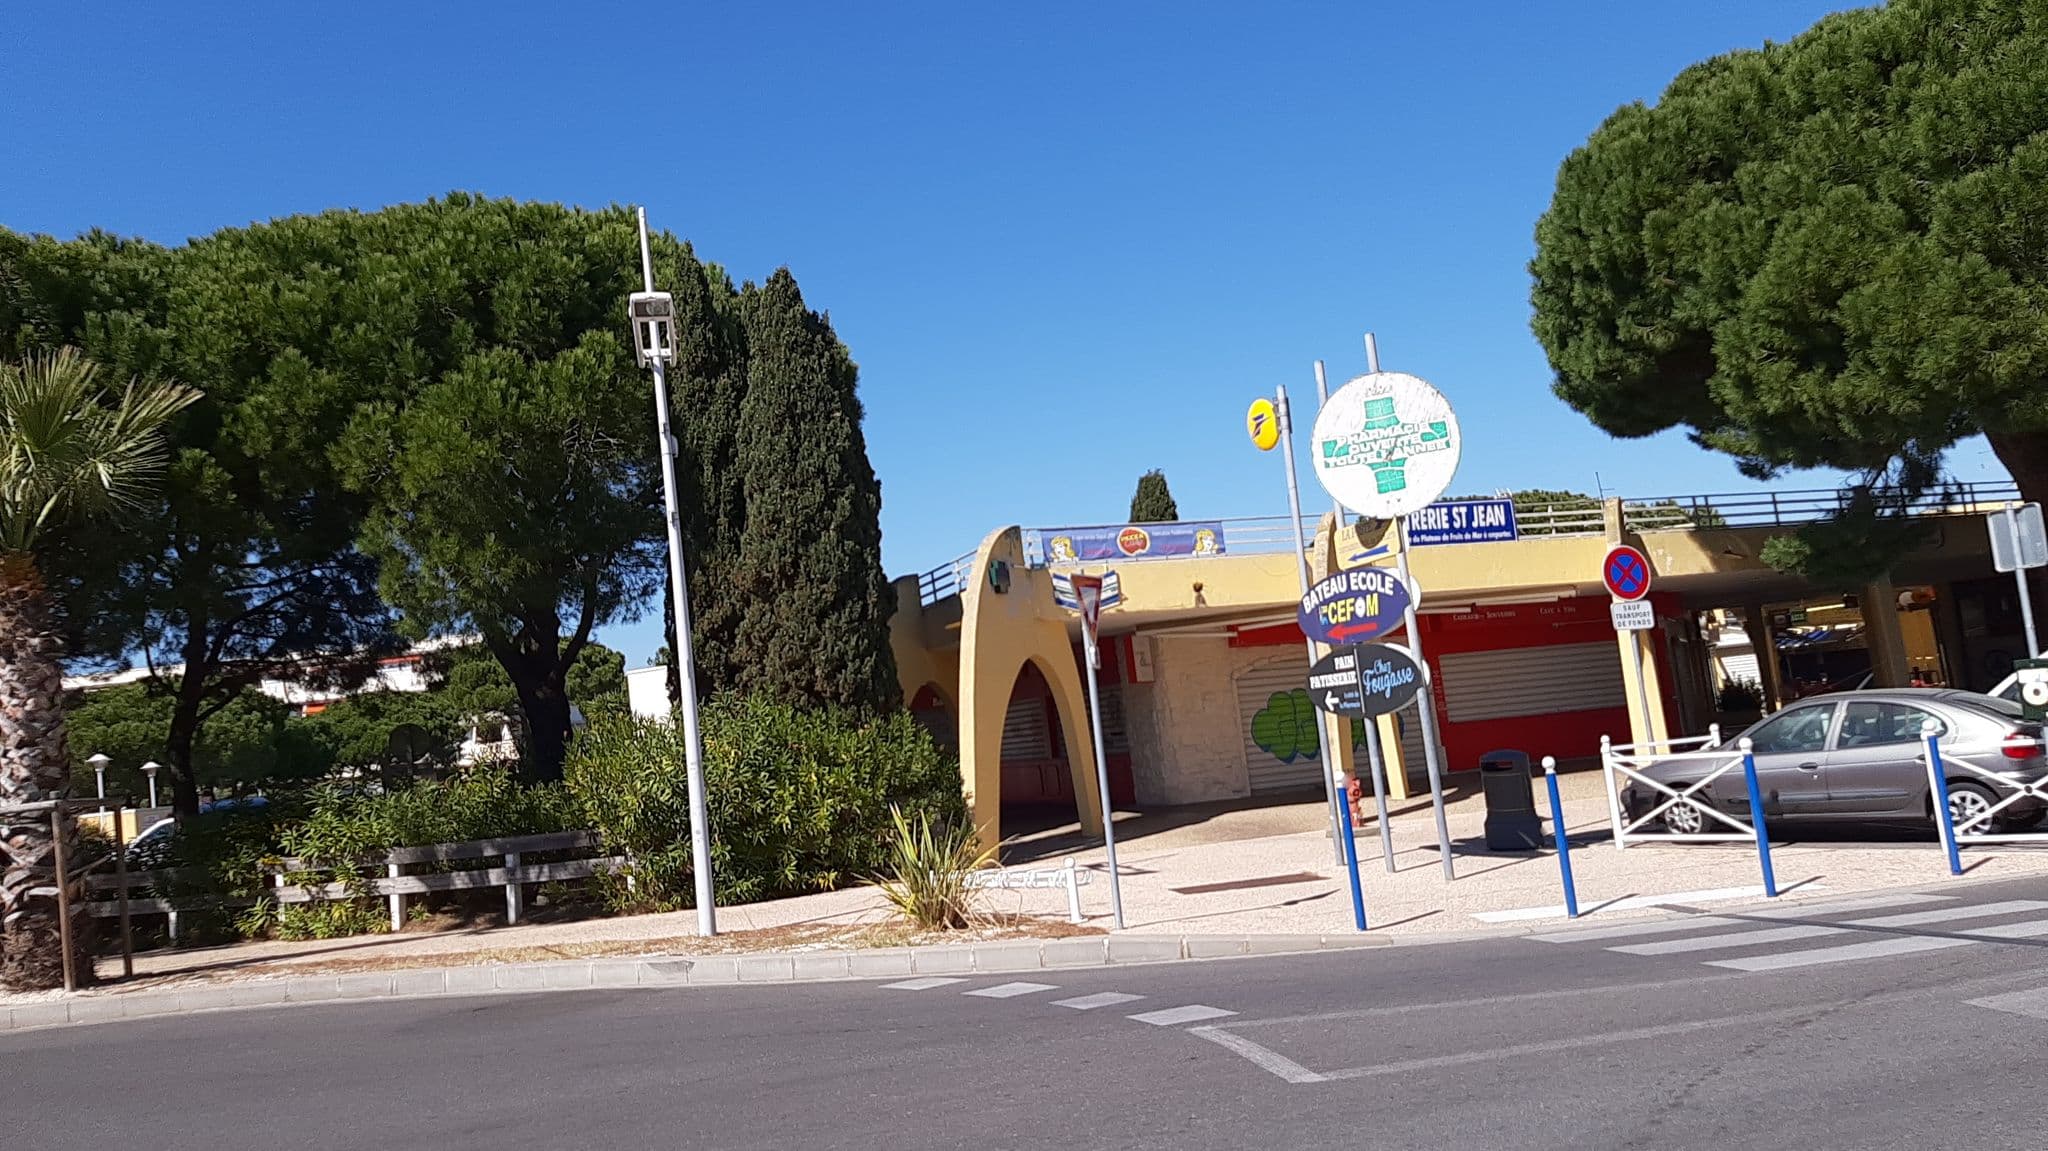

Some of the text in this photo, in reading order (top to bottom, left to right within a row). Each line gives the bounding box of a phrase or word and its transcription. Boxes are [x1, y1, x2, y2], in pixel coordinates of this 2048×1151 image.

[1335, 422, 1430, 450] PHARMACIE
[1348, 434, 1420, 456] OUVERTE
[1325, 450, 1378, 468] TOUTE
[1452, 506, 1467, 529] ST
[1471, 504, 1506, 528] JEAN
[1472, 531, 1482, 539] Mer
[1302, 572, 1394, 615] BATEAU ECOLE
[1616, 611, 1650, 619] TRANSPORT
[1622, 604, 1640, 612] SAUF
[1617, 620, 1626, 628] DE
[1334, 655, 1354, 670] PAIN
[1374, 659, 1391, 675] Chez
[1362, 666, 1414, 698] Fougasse
